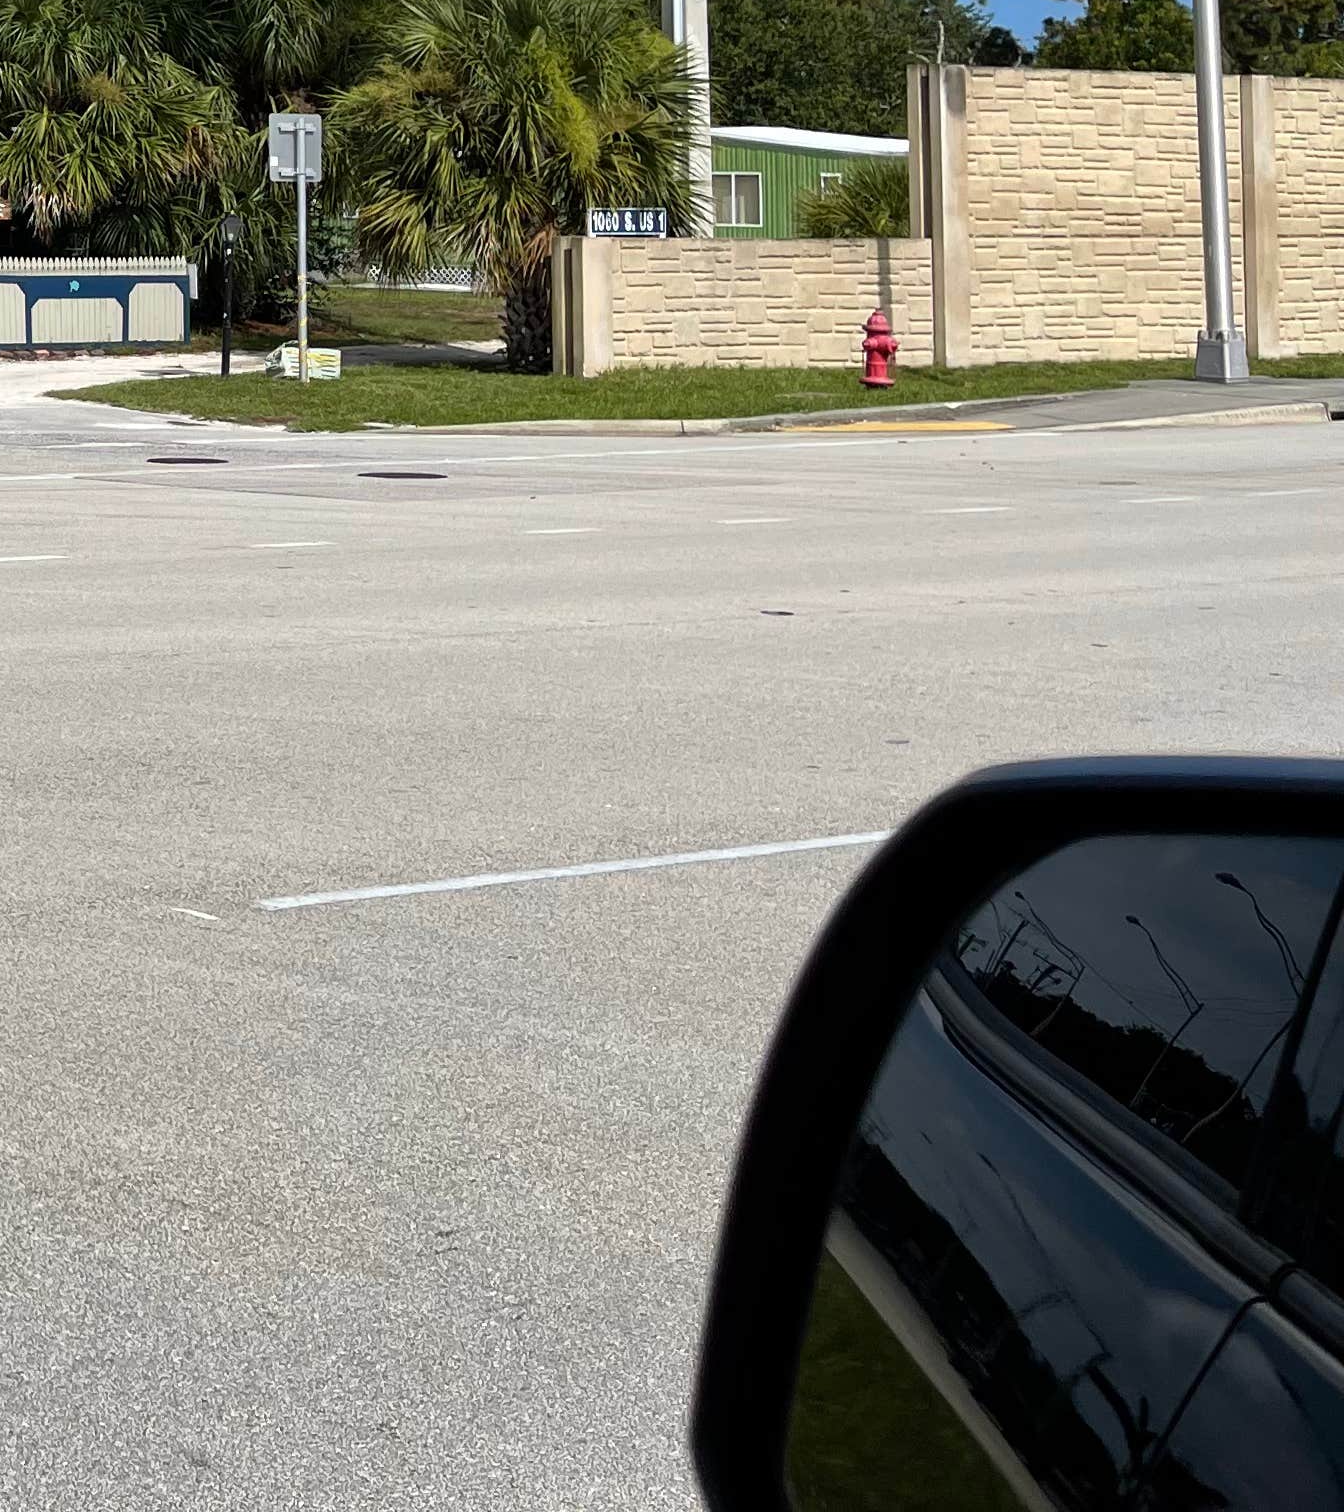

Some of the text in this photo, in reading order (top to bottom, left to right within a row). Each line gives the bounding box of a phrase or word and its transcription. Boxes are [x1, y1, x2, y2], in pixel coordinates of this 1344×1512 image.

[593, 211, 664, 231] 1060 S. US 1
